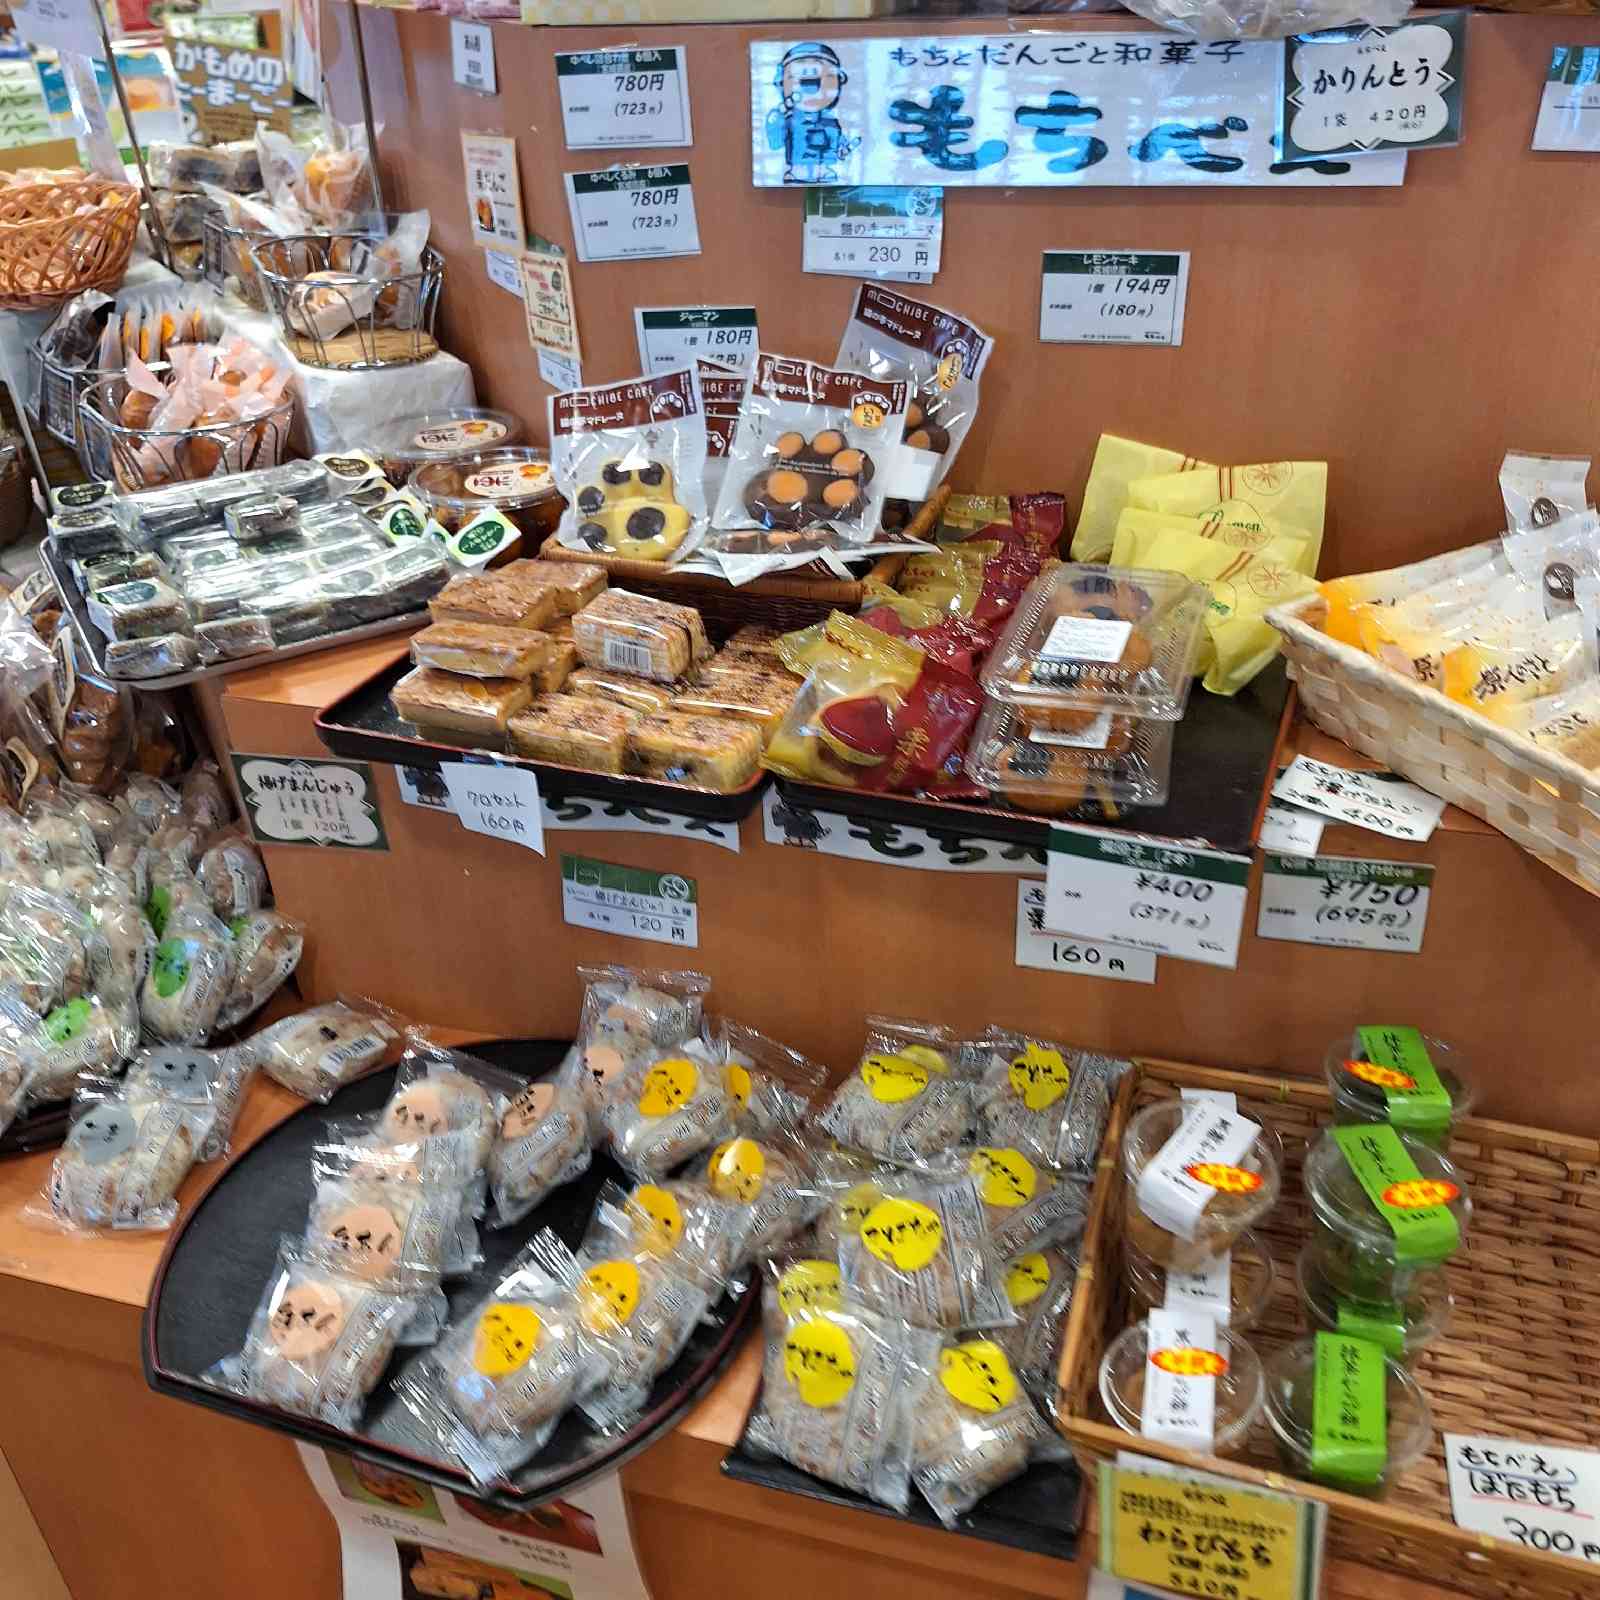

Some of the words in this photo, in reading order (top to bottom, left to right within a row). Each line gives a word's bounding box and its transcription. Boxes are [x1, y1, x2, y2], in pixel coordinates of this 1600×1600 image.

[175, 42, 284, 86] かもめの
[890, 40, 1245, 67] もちとだんごと和菓子
[615, 74, 664, 92] 780円
[1313, 57, 1430, 95] かりんとう
[1369, 104, 1426, 123] 420円
[631, 188, 679, 207] 780円
[868, 247, 901, 262] 230
[915, 251, 928, 266] 円
[1082, 254, 1139, 265] レモンケーキ
[1114, 277, 1170, 295] 194円
[679, 311, 720, 322] ジャーマン
[1100, 302, 1154, 318] (180円)
[932, 315, 960, 336] CAFE
[706, 328, 752, 346] 180円
[258, 773, 355, 797] 揚げまんじゅう
[314, 819, 351, 834] 120円
[479, 811, 526, 834] 160円
[1341, 807, 1394, 829] 400
[1134, 872, 1215, 903] ¥400
[1319, 876, 1420, 906] ¥750
[630, 913, 662, 932] 120
[671, 926, 686, 941] 円
[1052, 941, 1101, 964] 160
[1108, 957, 1125, 972] 円
[1468, 1470, 1576, 1513] ぼたもち
[1503, 1516, 1575, 1552] 200
